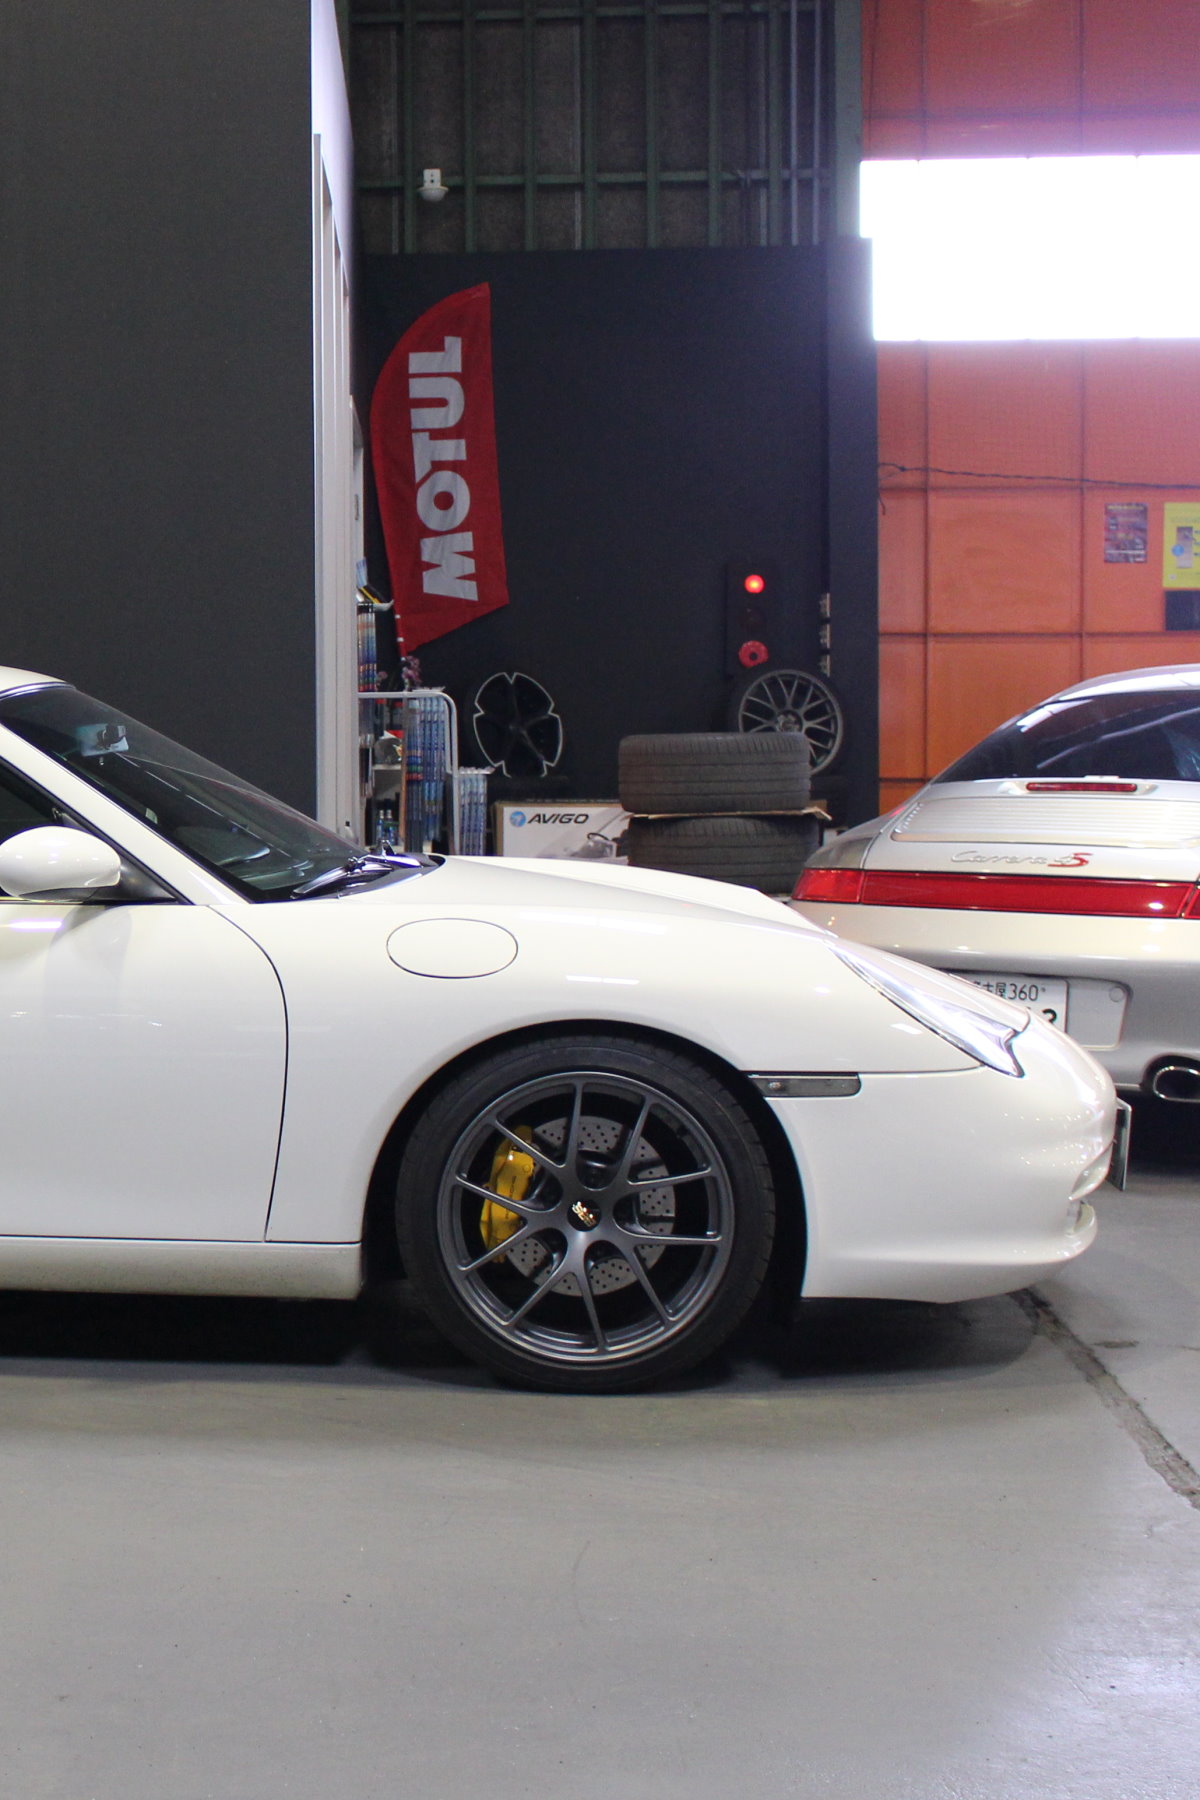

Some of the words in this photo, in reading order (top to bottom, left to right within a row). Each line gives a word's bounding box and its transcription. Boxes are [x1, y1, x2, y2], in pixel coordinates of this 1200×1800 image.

[408, 336, 478, 601] MOTUL
[527, 813, 589, 825] AVIGO
[951, 850, 1047, 865] Carrera
